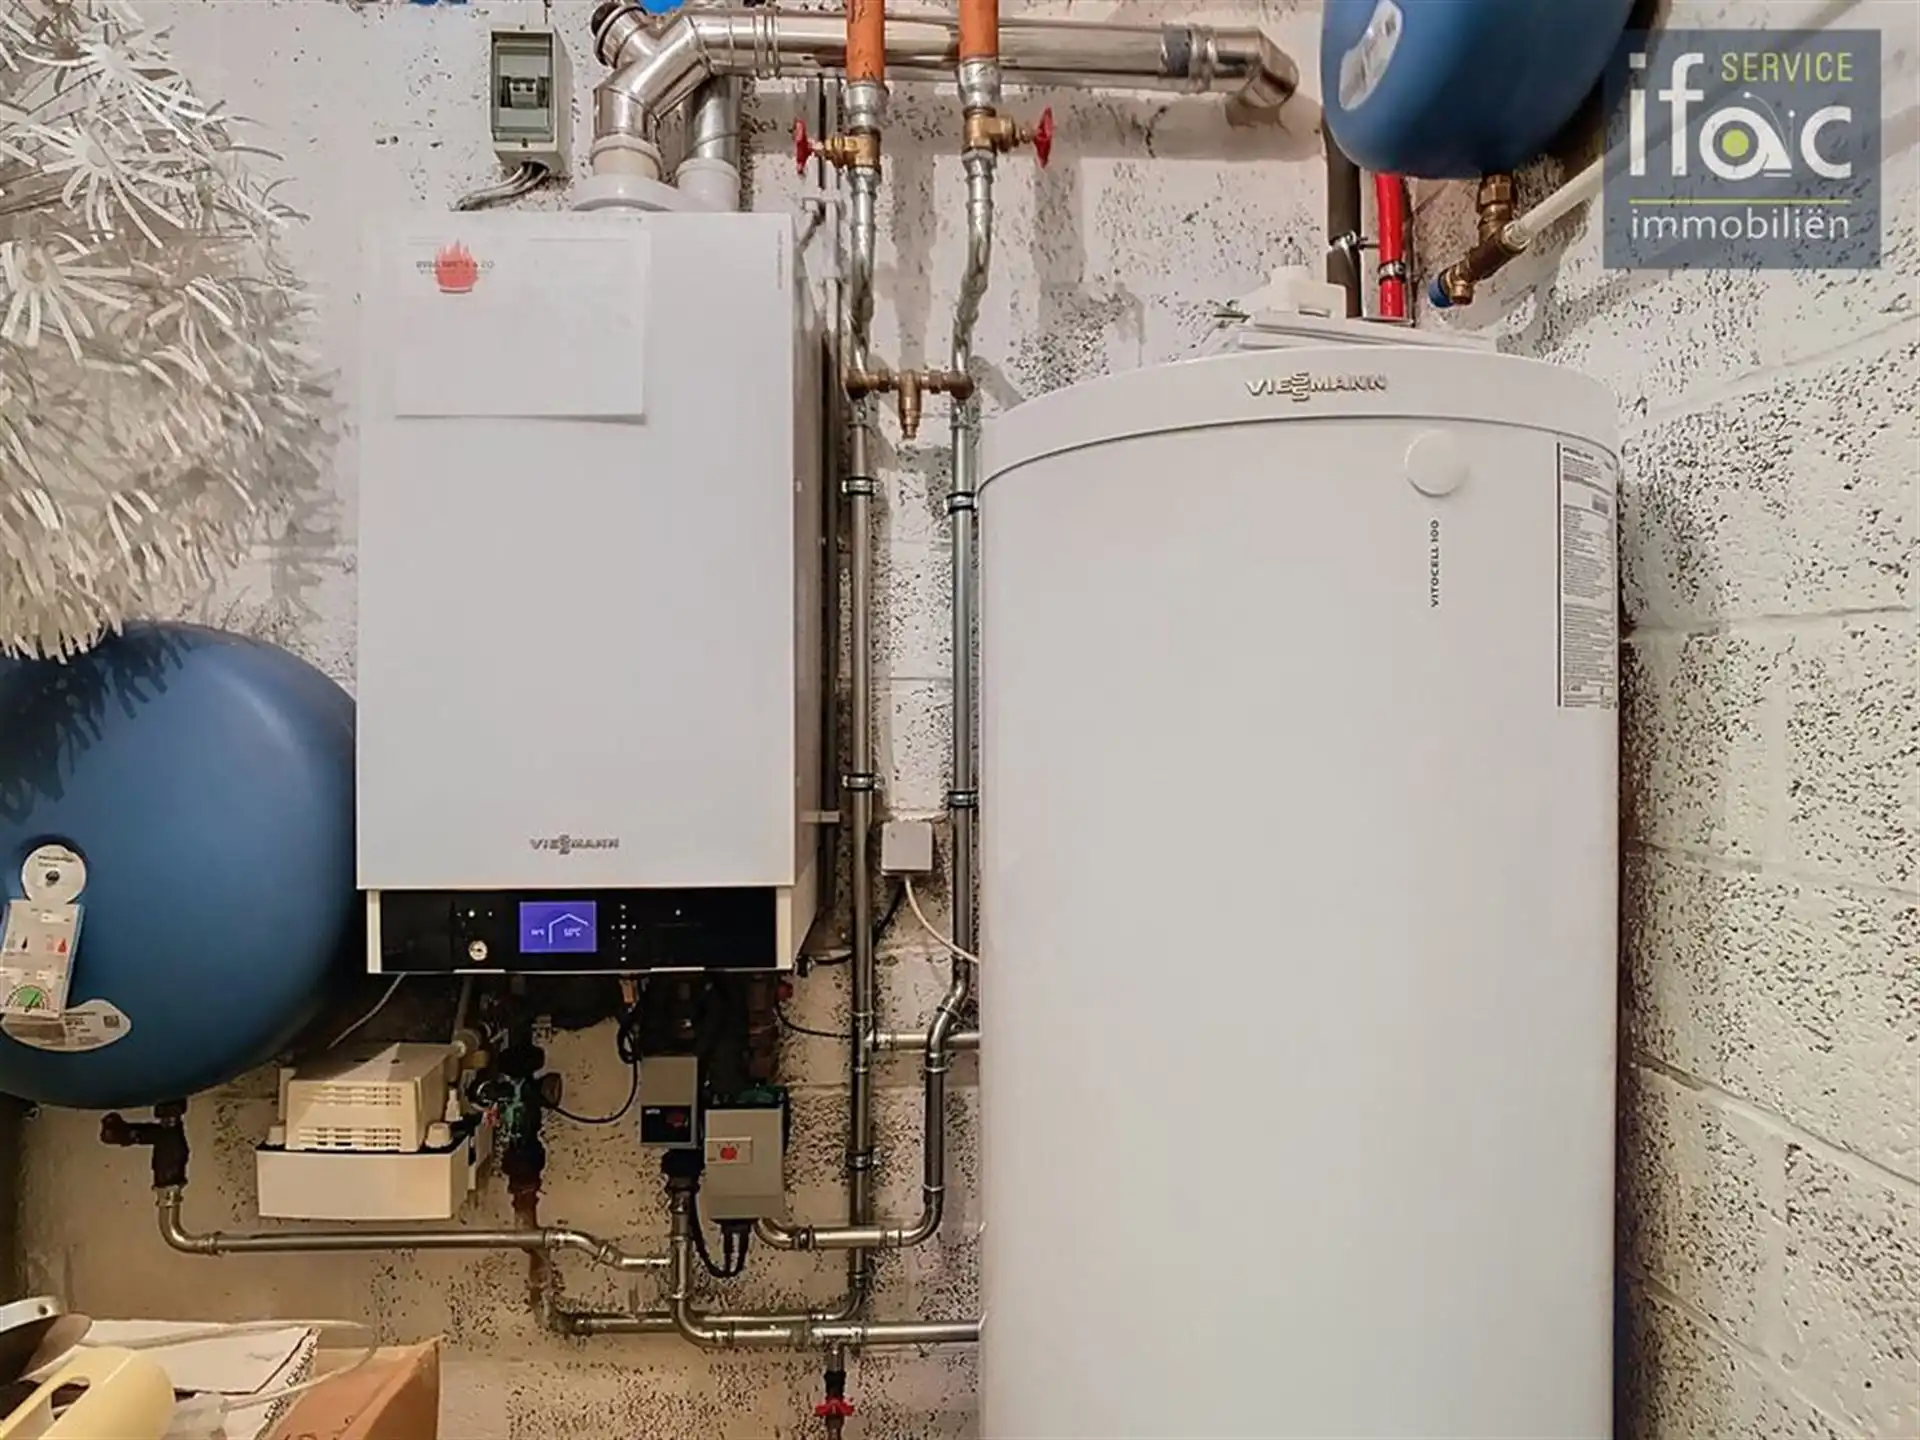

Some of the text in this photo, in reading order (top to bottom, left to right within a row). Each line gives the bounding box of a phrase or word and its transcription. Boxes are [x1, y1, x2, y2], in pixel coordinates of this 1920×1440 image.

[1245, 371, 1388, 402] VIESSMANN
[1429, 519, 1440, 608] VITOCELL 100
[529, 833, 620, 855] VIESSMANN
